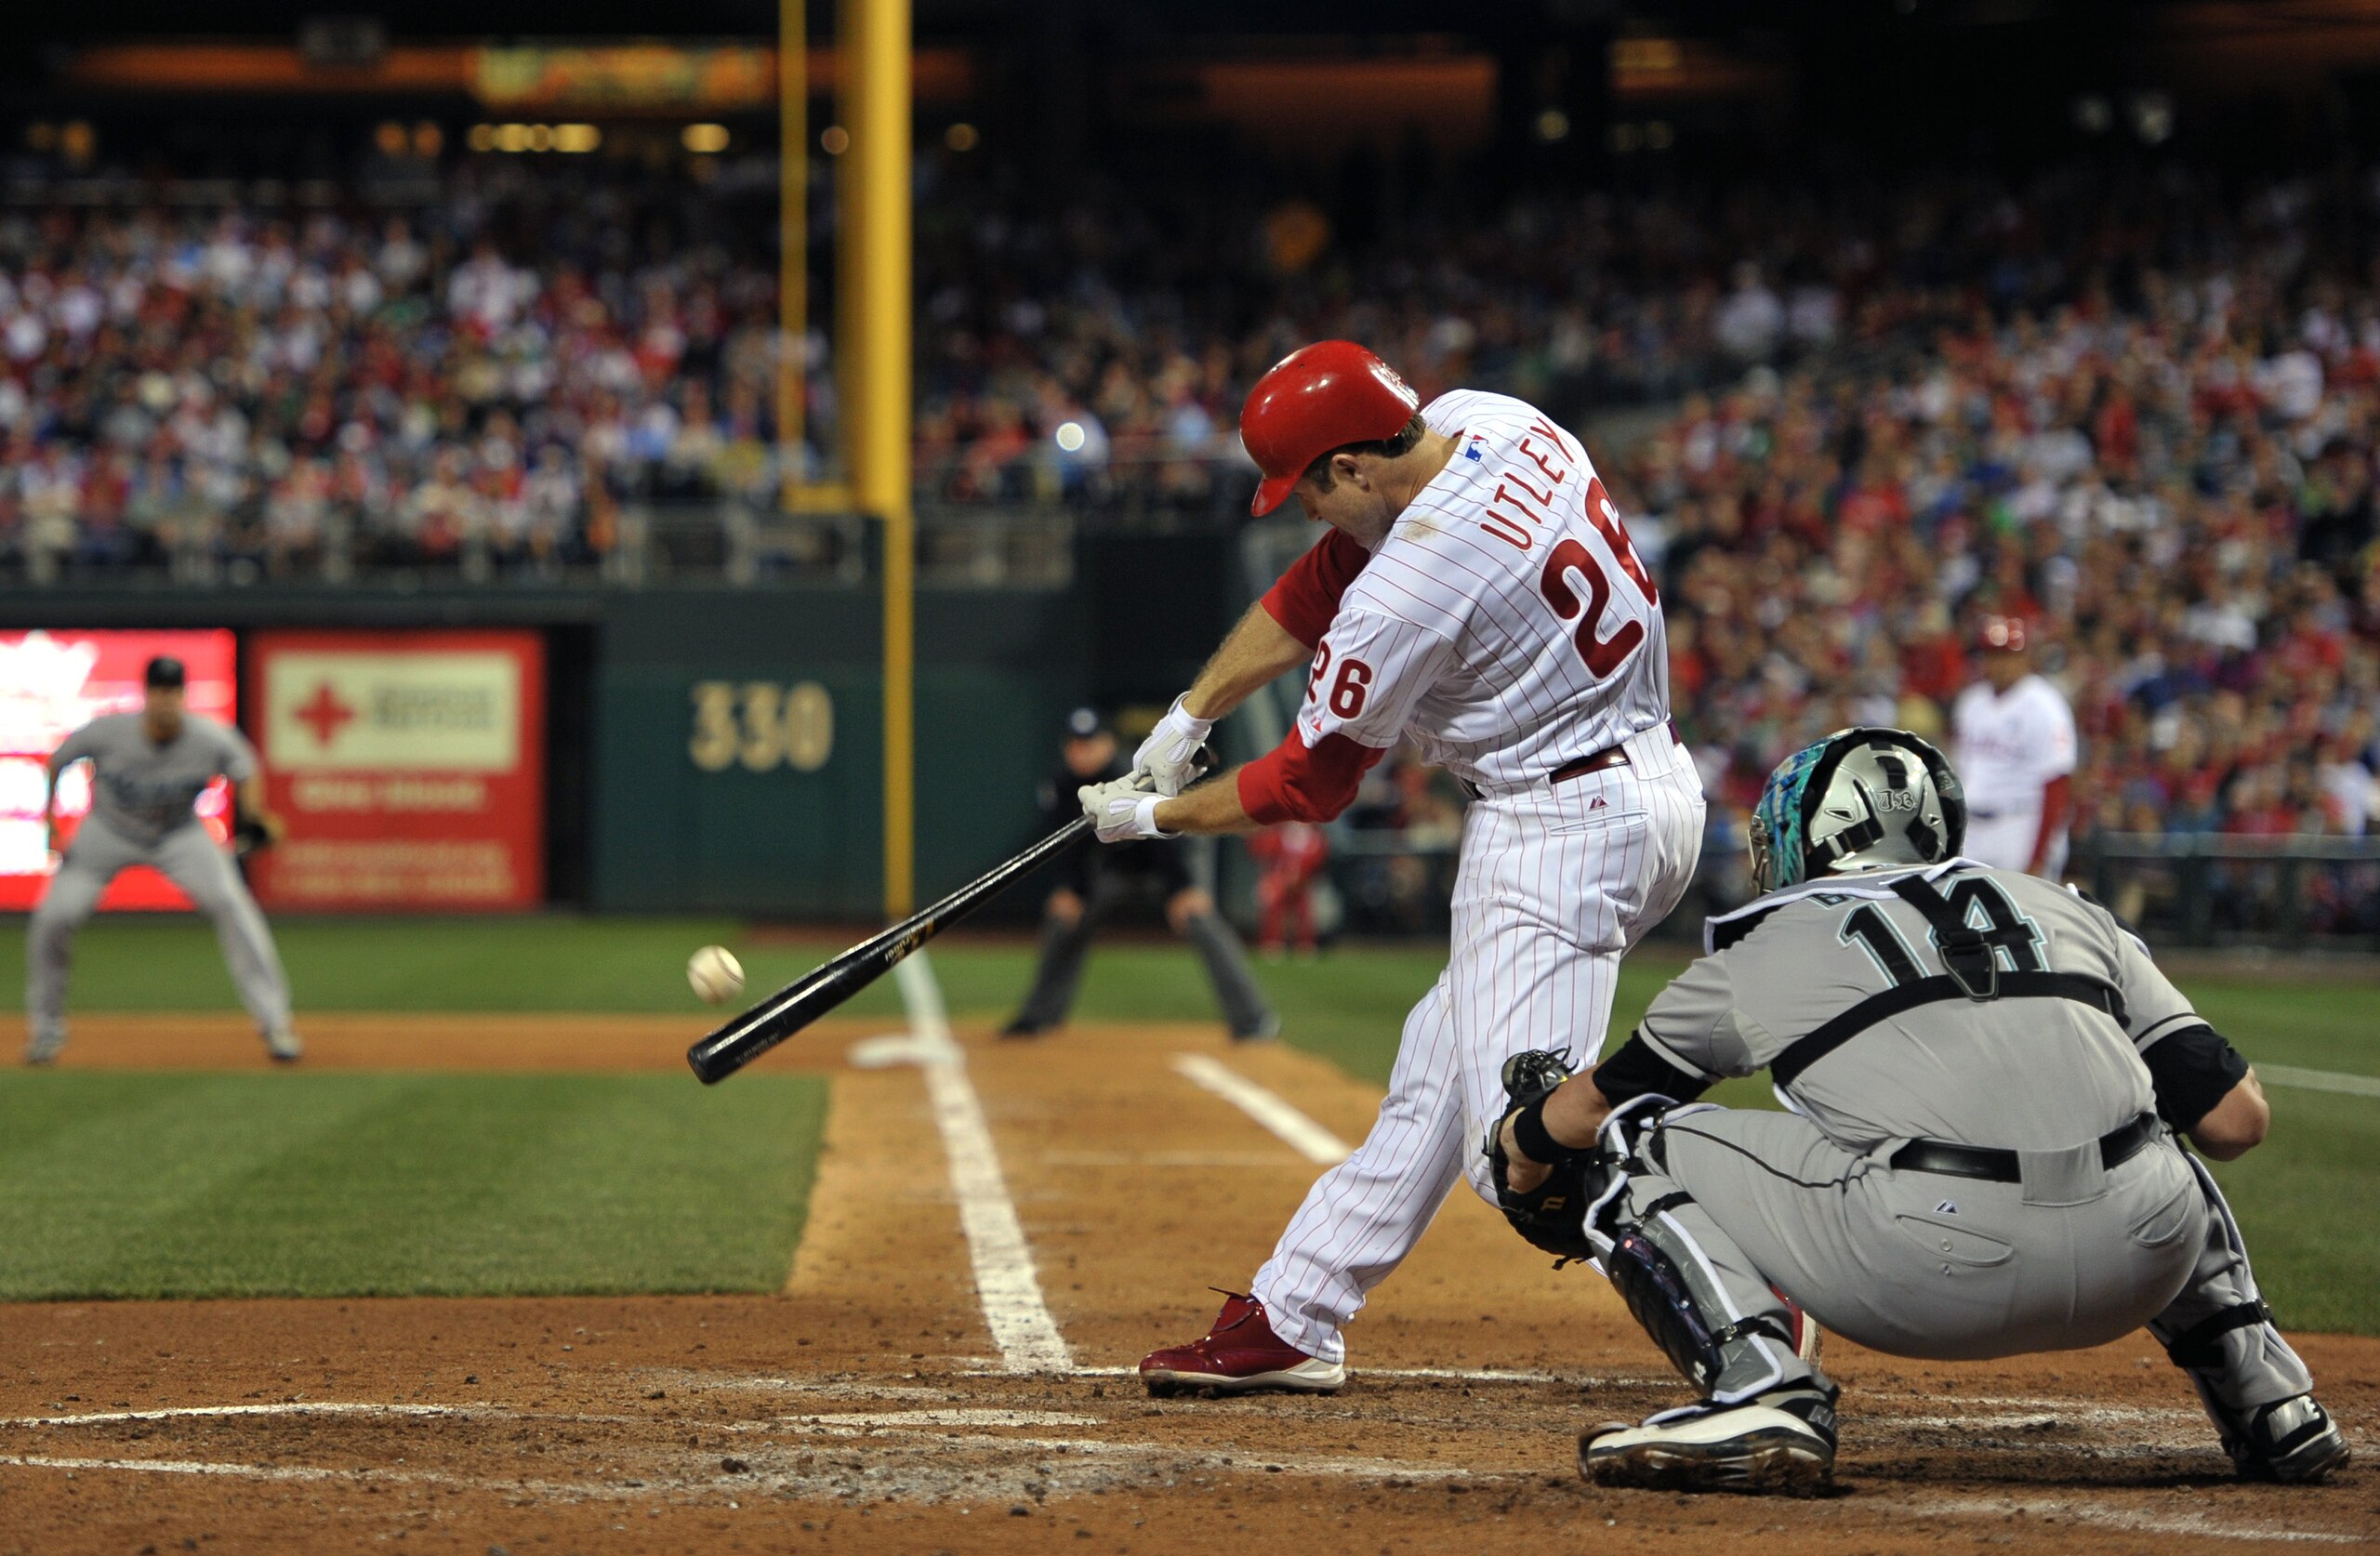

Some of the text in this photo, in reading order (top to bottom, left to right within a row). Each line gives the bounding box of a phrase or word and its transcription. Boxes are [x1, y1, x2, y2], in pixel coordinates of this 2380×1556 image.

[1479, 416, 1575, 551] UTLEY
[689, 679, 835, 773] 330
[1307, 640, 1373, 721] 26
[1837, 874, 2051, 989] 14
